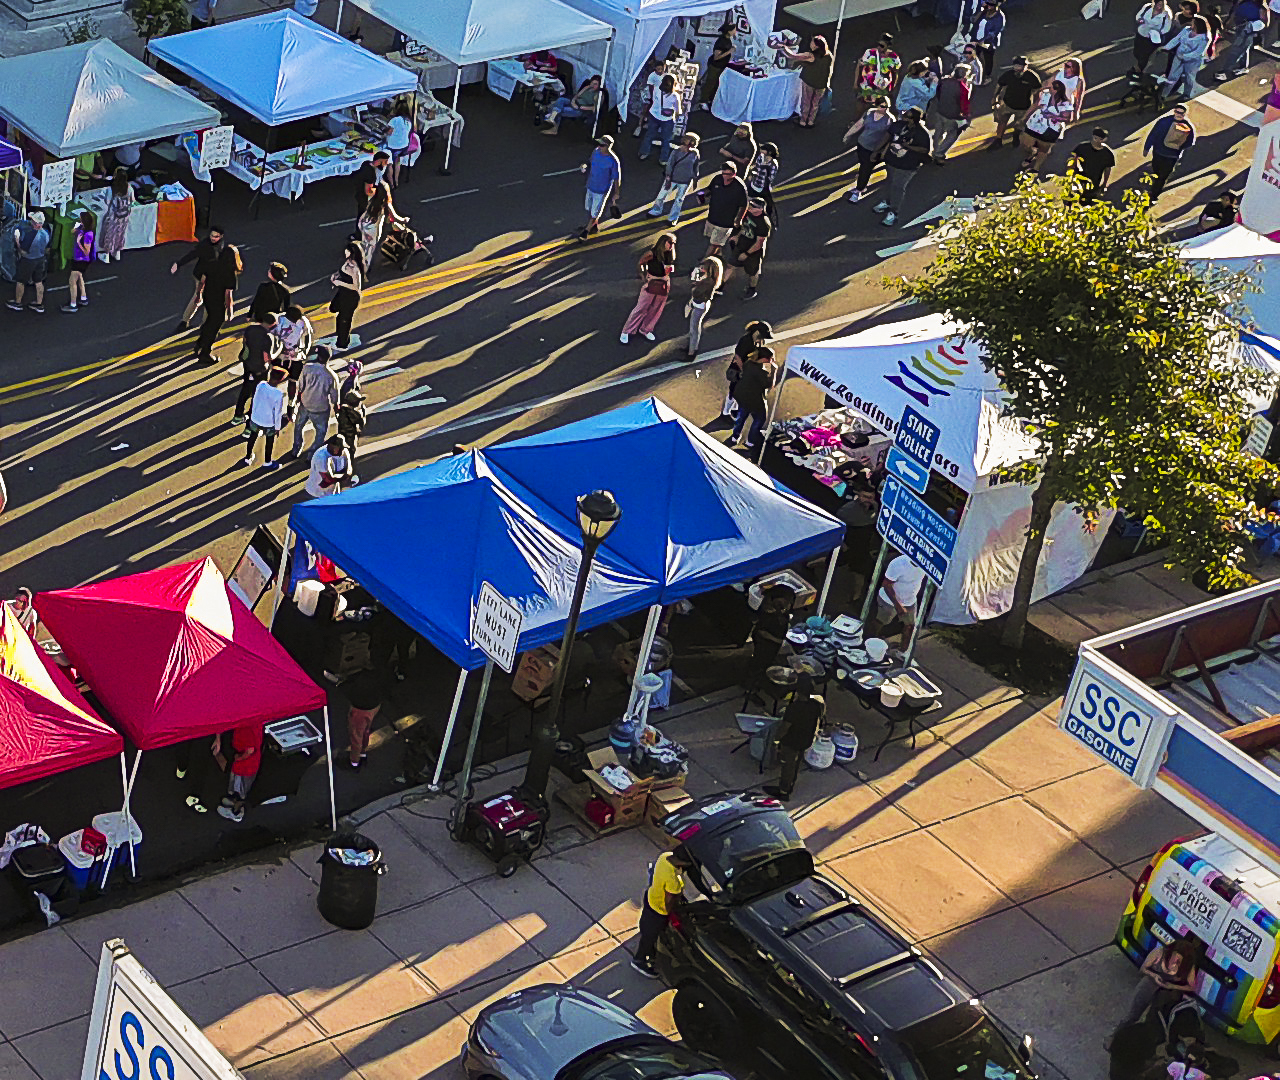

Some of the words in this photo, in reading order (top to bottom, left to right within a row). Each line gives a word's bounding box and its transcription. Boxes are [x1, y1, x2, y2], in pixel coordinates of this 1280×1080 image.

[898, 430, 931, 464] POLICE
[906, 414, 934, 443] STATE
[900, 489, 926, 519] Reading
[927, 513, 955, 541] Hospital
[901, 505, 924, 532] Trauma
[925, 528, 947, 550] Center
[888, 528, 914, 556] PUBLIC
[916, 551, 943, 582] MUSEUM
[905, 527, 935, 558] READING
[482, 591, 498, 612] LEFT
[500, 602, 517, 629] LANE
[485, 612, 507, 640] MUST
[475, 625, 491, 646] TURN
[493, 641, 510, 662] LEFT
[1080, 683, 1140, 746] SSC
[1067, 718, 1133, 770] GASOLINE
[1181, 886, 1216, 920] PRIDE
